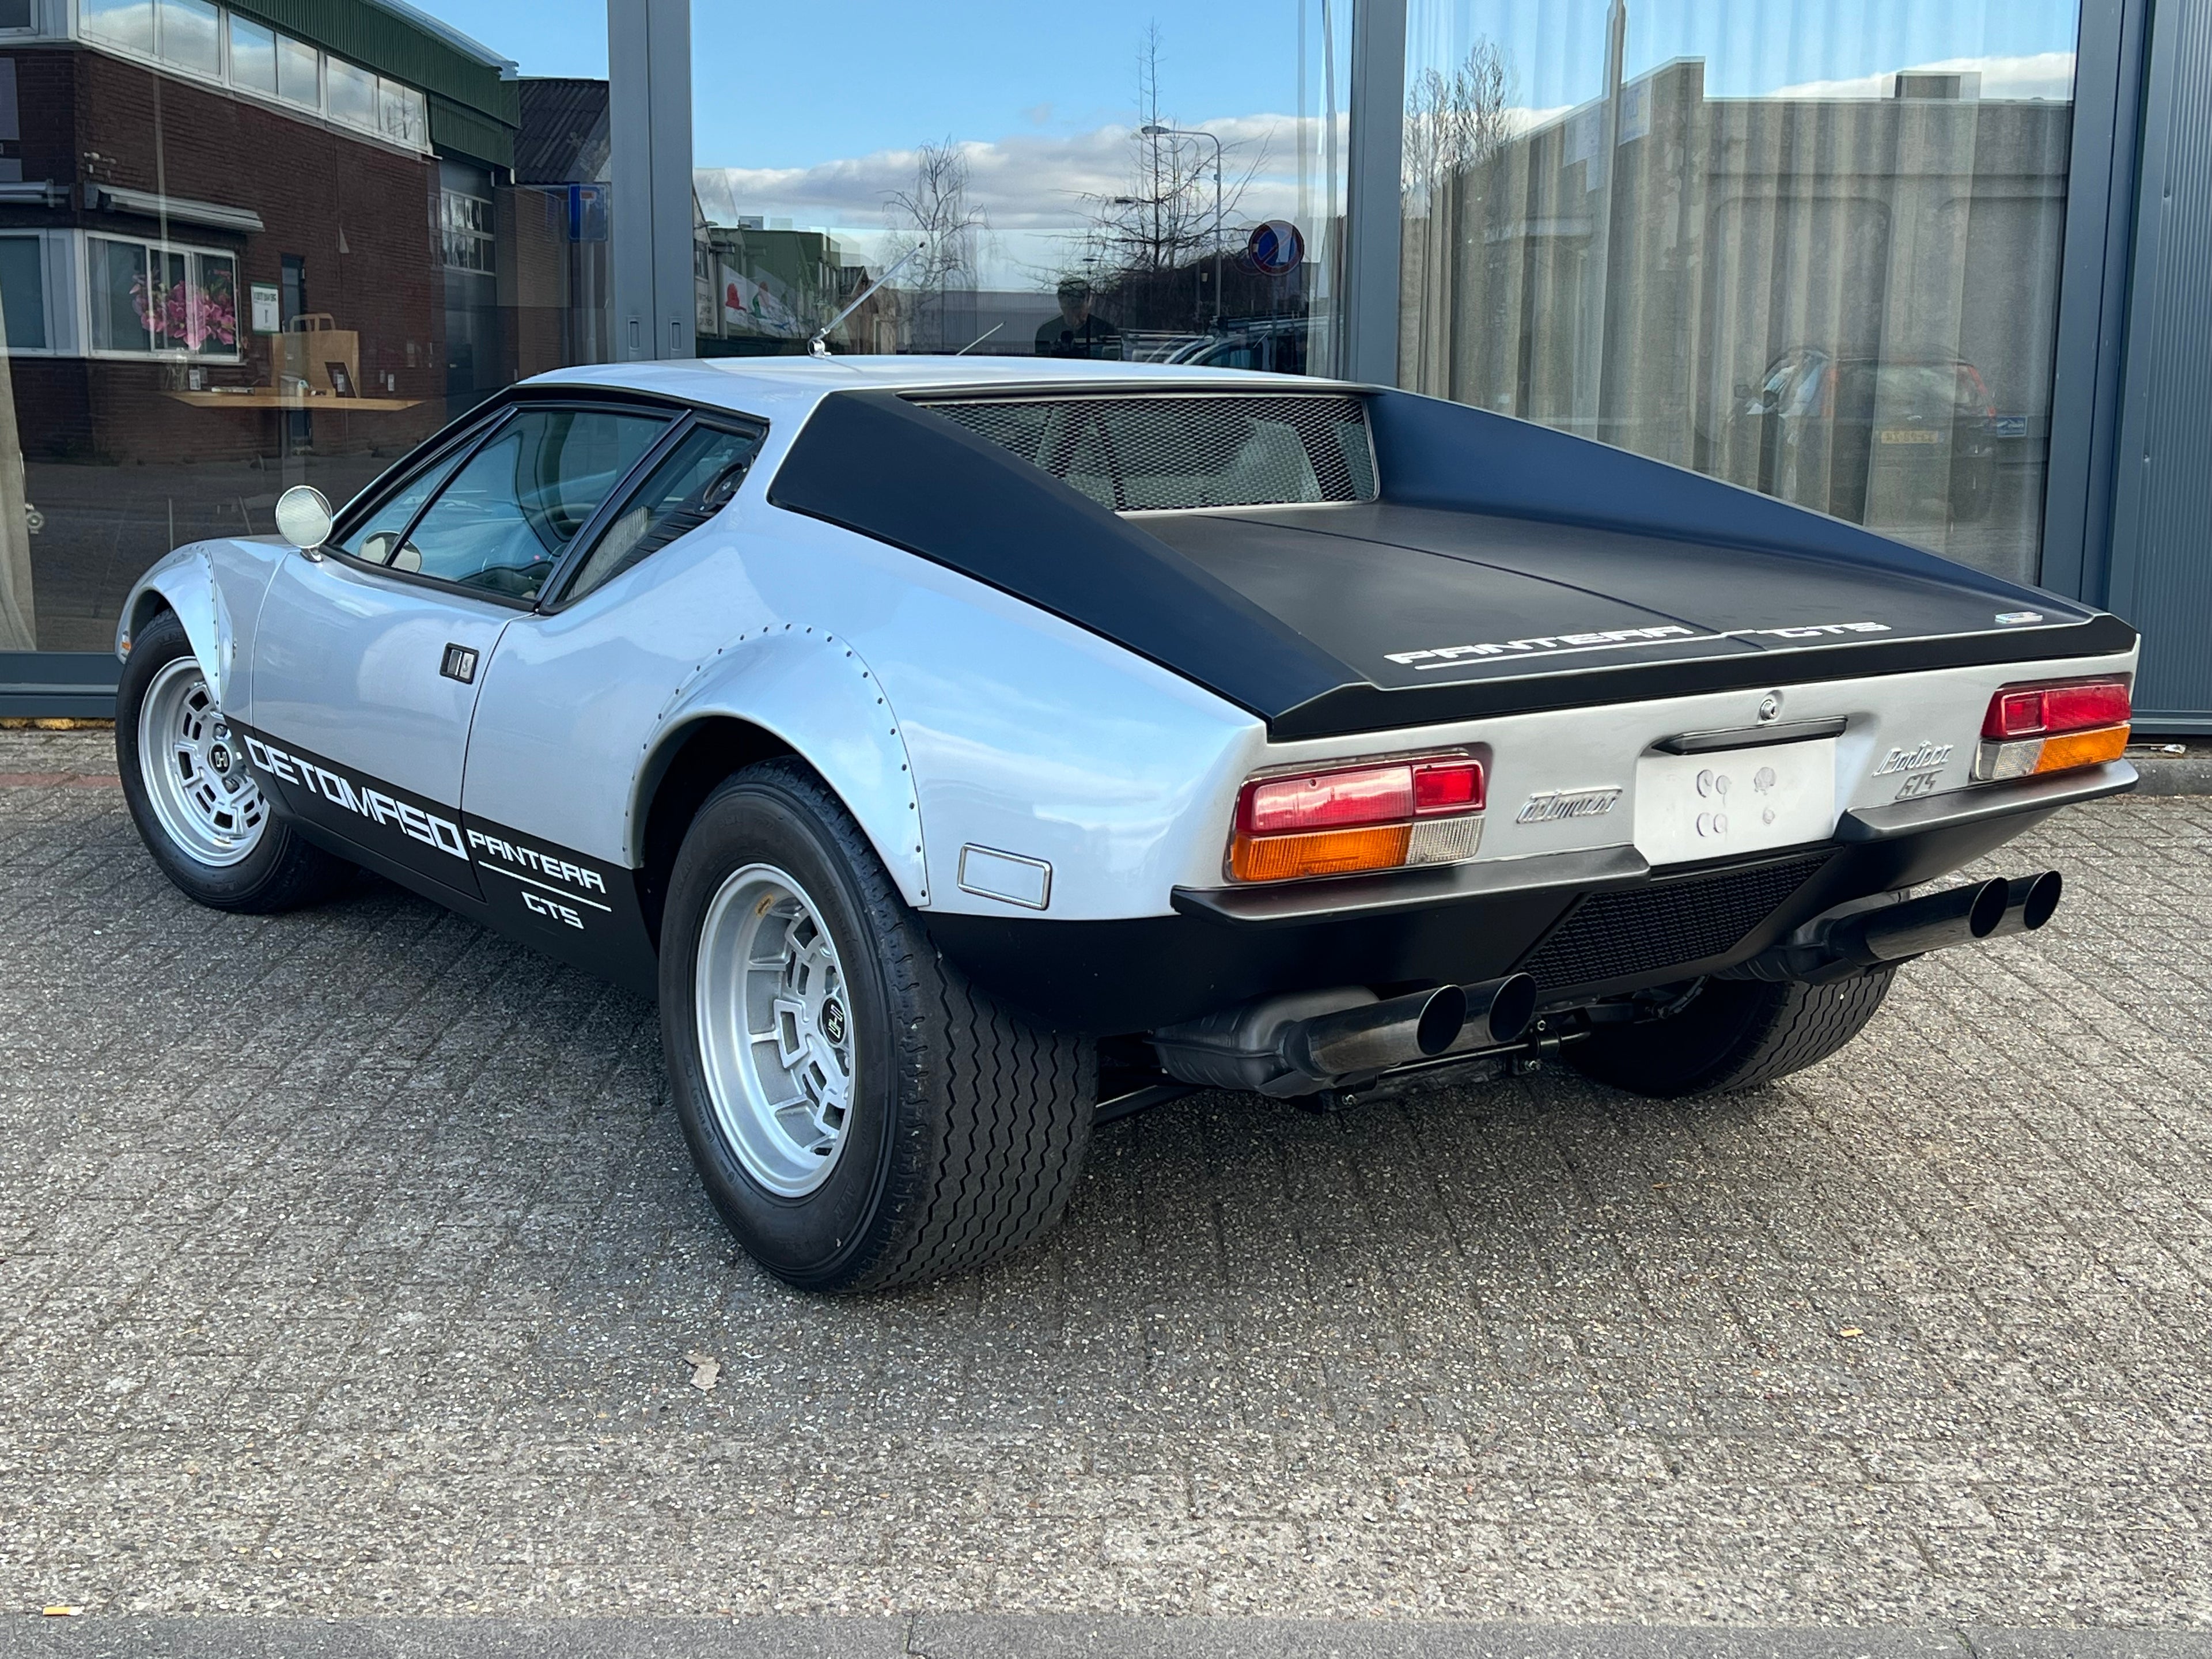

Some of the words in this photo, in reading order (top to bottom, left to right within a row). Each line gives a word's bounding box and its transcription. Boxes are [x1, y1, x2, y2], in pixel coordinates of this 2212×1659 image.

[1384, 626, 1694, 664] PANTERA
[243, 734, 470, 861] DETOMASO
[1895, 768, 1944, 800] GTS
[466, 828, 607, 894] PANTERA
[521, 891, 585, 930] GTS
